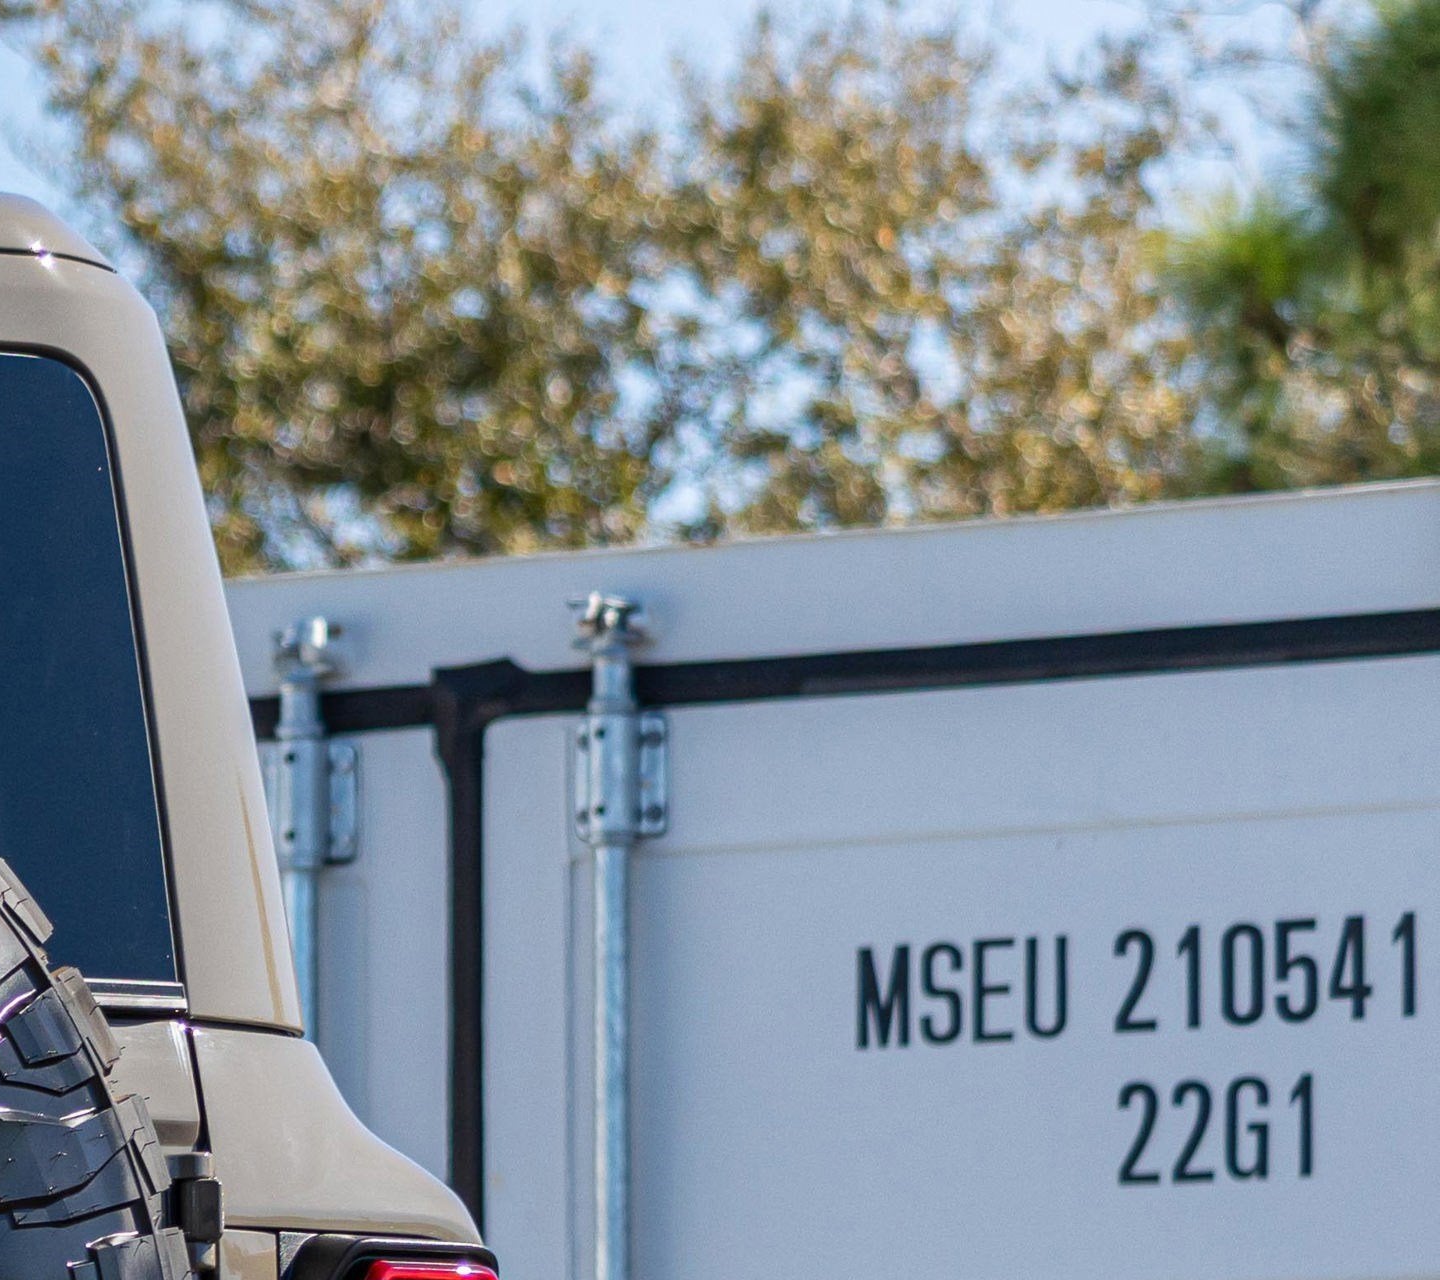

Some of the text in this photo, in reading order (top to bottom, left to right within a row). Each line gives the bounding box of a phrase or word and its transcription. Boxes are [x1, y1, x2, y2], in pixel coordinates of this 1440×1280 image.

[856, 911, 1419, 1050] MSEU 210541
[1118, 1073, 1316, 1186] 22G1
